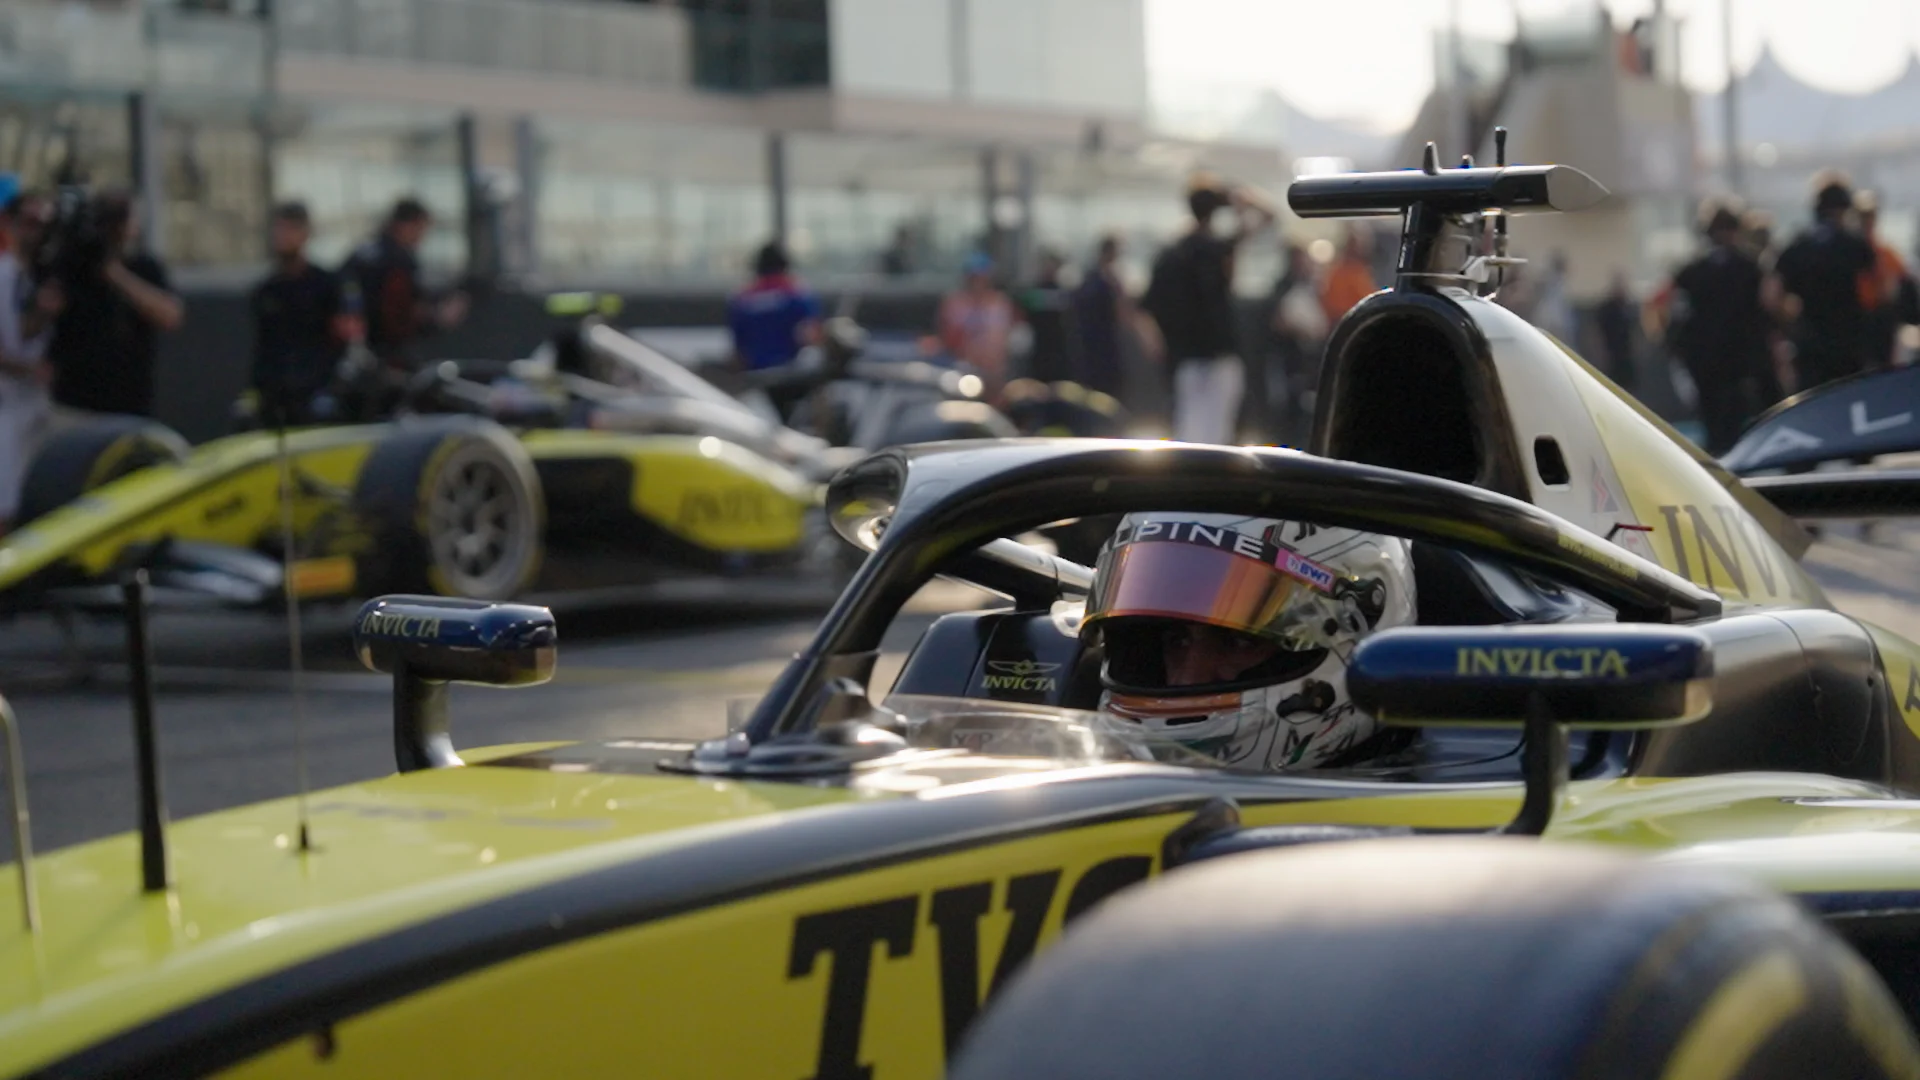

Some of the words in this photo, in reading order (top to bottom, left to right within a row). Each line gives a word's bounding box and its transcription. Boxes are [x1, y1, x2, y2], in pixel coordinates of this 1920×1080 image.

[1104, 521, 1264, 560] LPINE
[1659, 505, 1802, 598] INV
[1300, 561, 1331, 585] BWT
[361, 614, 440, 638] INVICTA
[1457, 647, 1627, 678] INVICTA
[981, 674, 1056, 691] INVICTA
